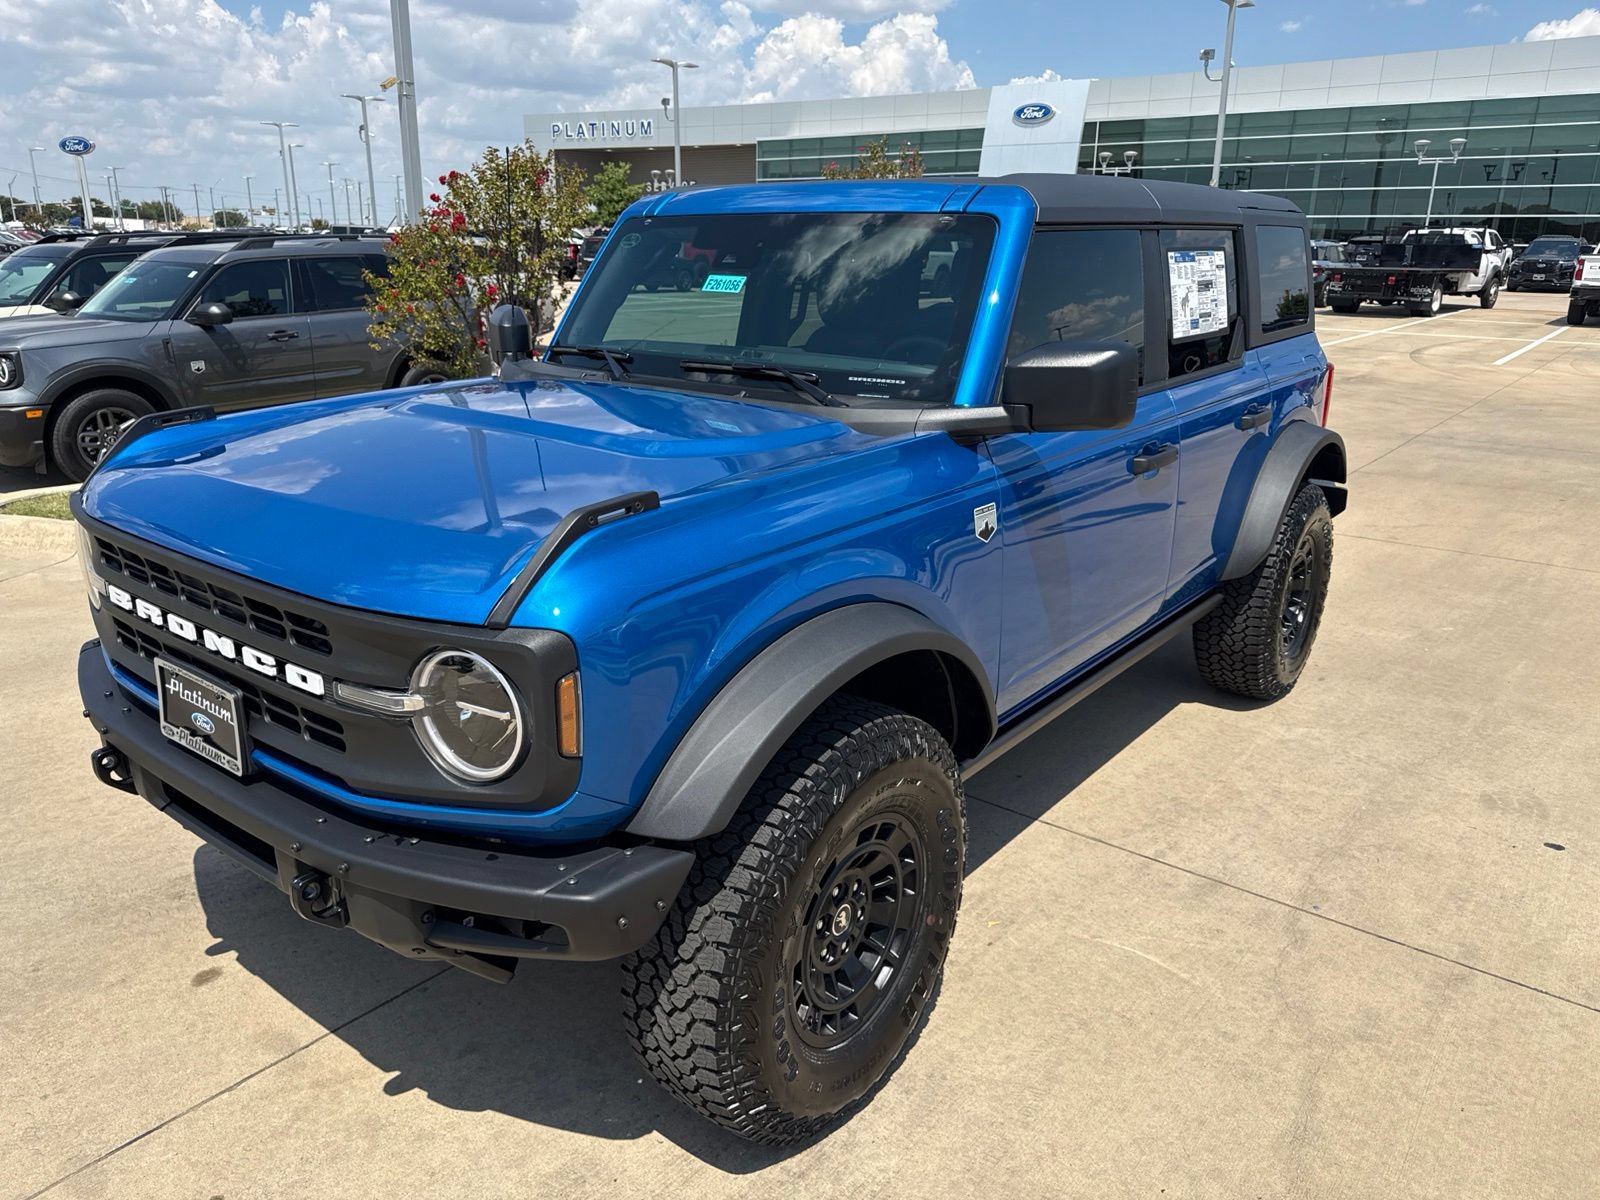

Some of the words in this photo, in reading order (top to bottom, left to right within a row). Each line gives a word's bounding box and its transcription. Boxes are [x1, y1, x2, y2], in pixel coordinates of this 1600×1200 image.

[551, 120, 653, 139] PLATINUM
[705, 279, 742, 291] F261056
[108, 584, 325, 696] BRONCO
[165, 678, 235, 726] Platinum
[179, 728, 226, 766] Platinum
